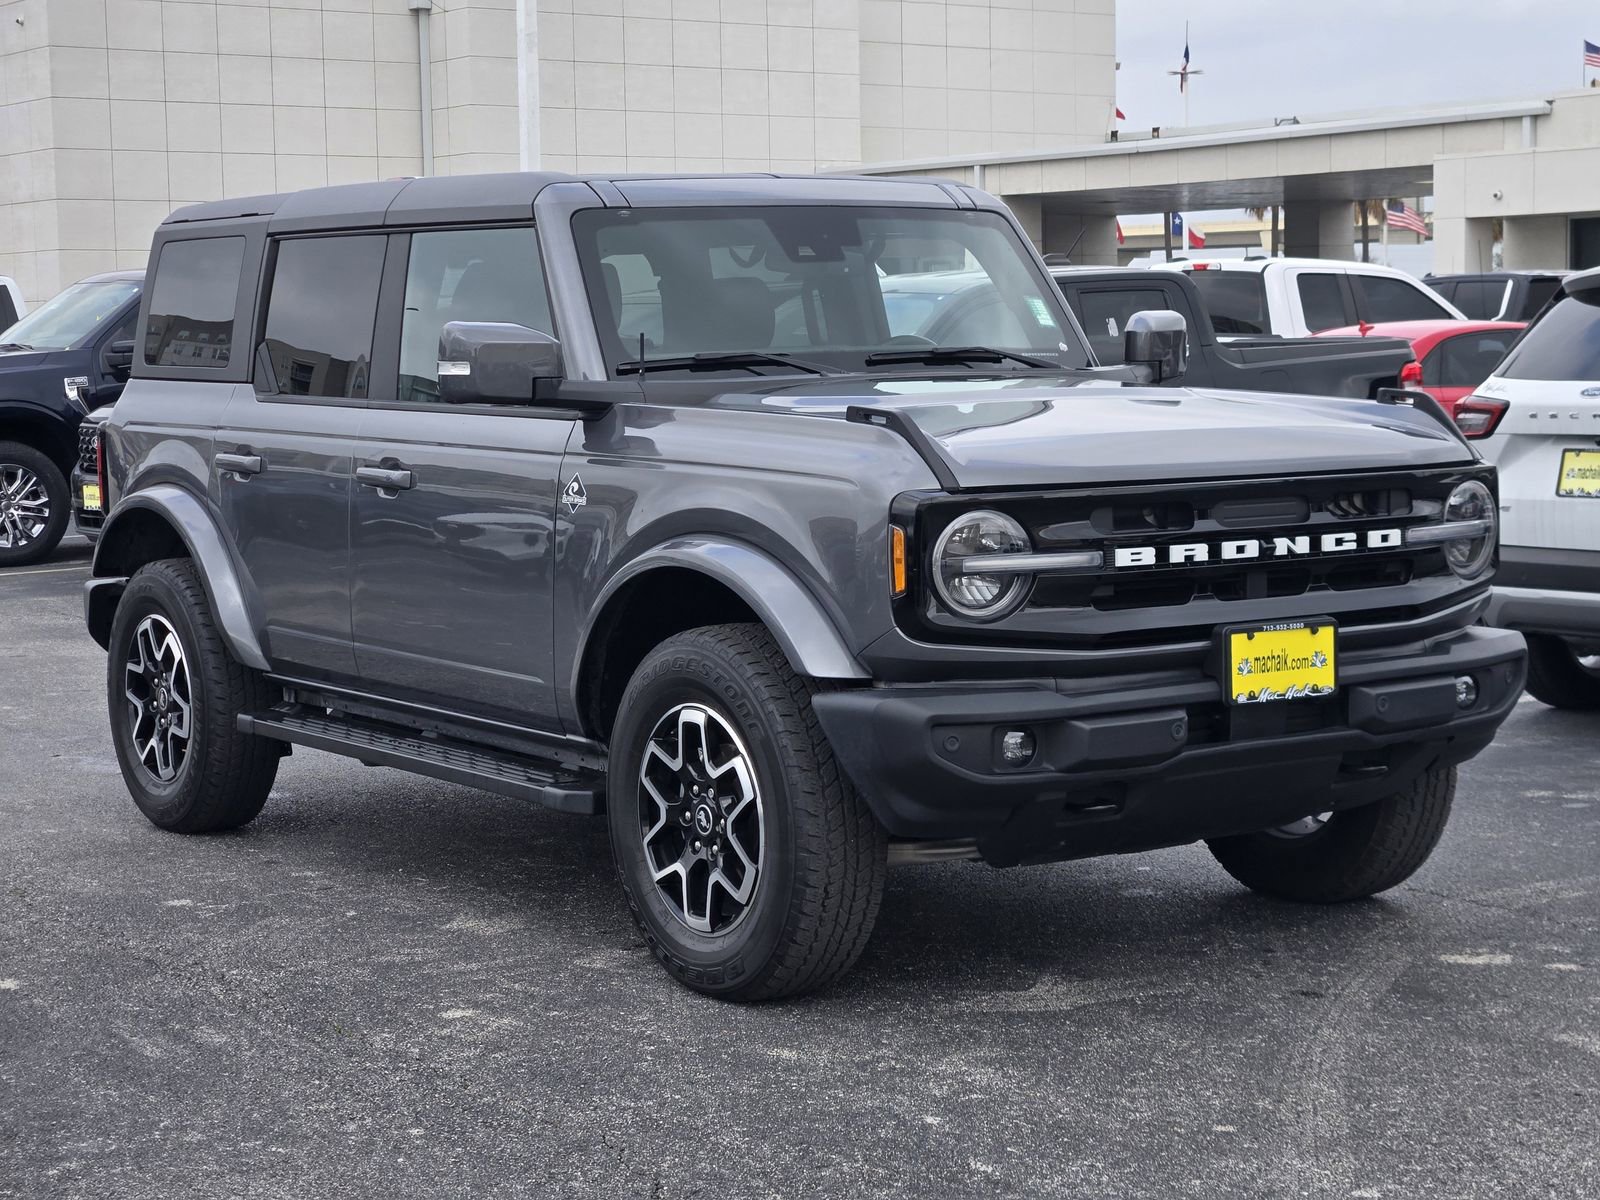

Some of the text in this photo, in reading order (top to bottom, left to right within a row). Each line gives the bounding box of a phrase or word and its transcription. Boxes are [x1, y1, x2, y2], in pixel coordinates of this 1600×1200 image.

[1114, 528, 1402, 567] BRONCO
[1253, 648, 1310, 674] machaik.com
[1258, 687, 1284, 703] Mac
[1285, 683, 1312, 700] Haik
